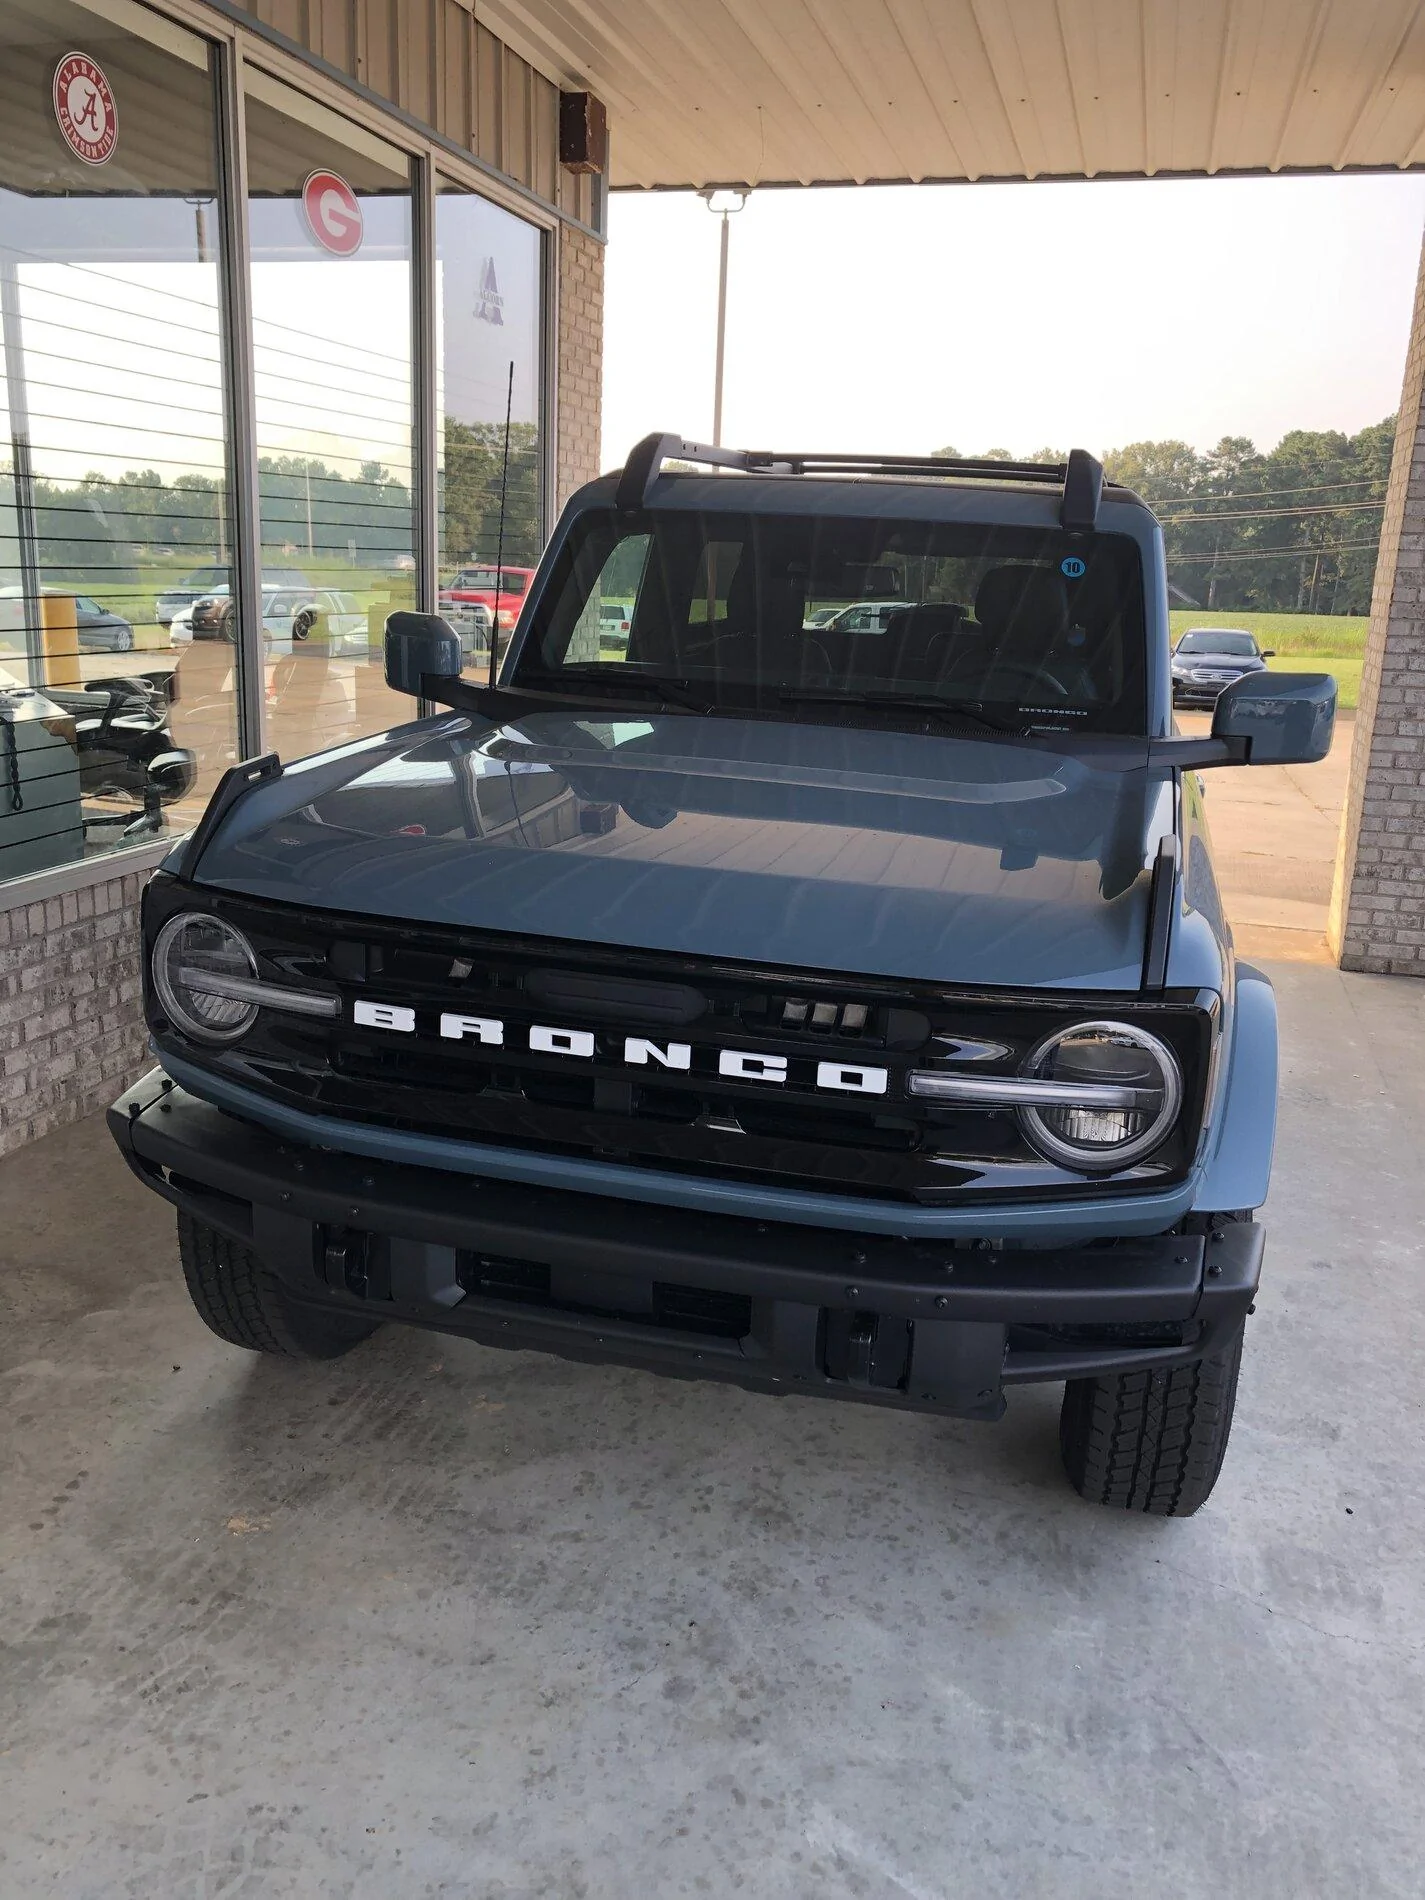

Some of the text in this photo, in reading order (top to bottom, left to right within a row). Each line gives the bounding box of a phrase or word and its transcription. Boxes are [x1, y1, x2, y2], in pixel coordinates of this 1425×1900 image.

[59, 61, 113, 112] ALABAMA
[60, 106, 114, 158] CRIMSON TIDE
[306, 174, 362, 252] G
[1065, 561, 1081, 574] 10
[353, 999, 889, 1095] BRONCO
